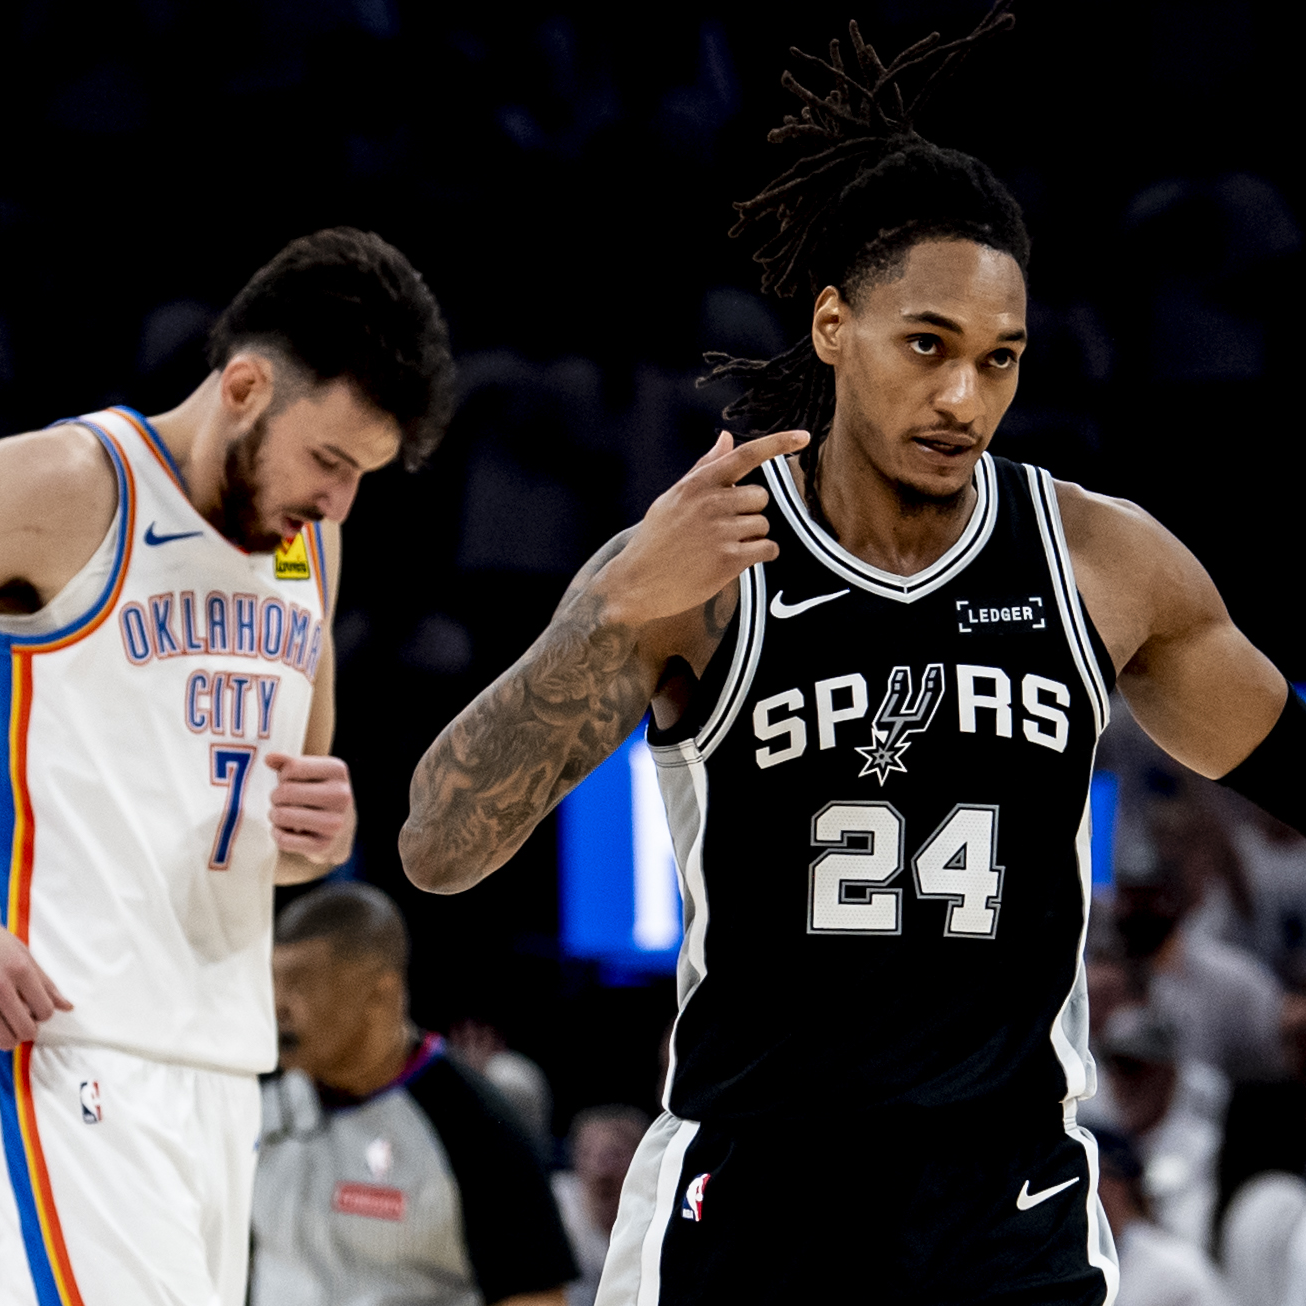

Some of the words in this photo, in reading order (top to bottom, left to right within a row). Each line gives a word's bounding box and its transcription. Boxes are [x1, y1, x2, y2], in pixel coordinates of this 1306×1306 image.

[968, 606, 1034, 623] LEDGER
[184, 669, 281, 740] CITY
[753, 663, 1071, 787] SPURS
[207, 743, 257, 871] 7
[806, 800, 1005, 940] 24
